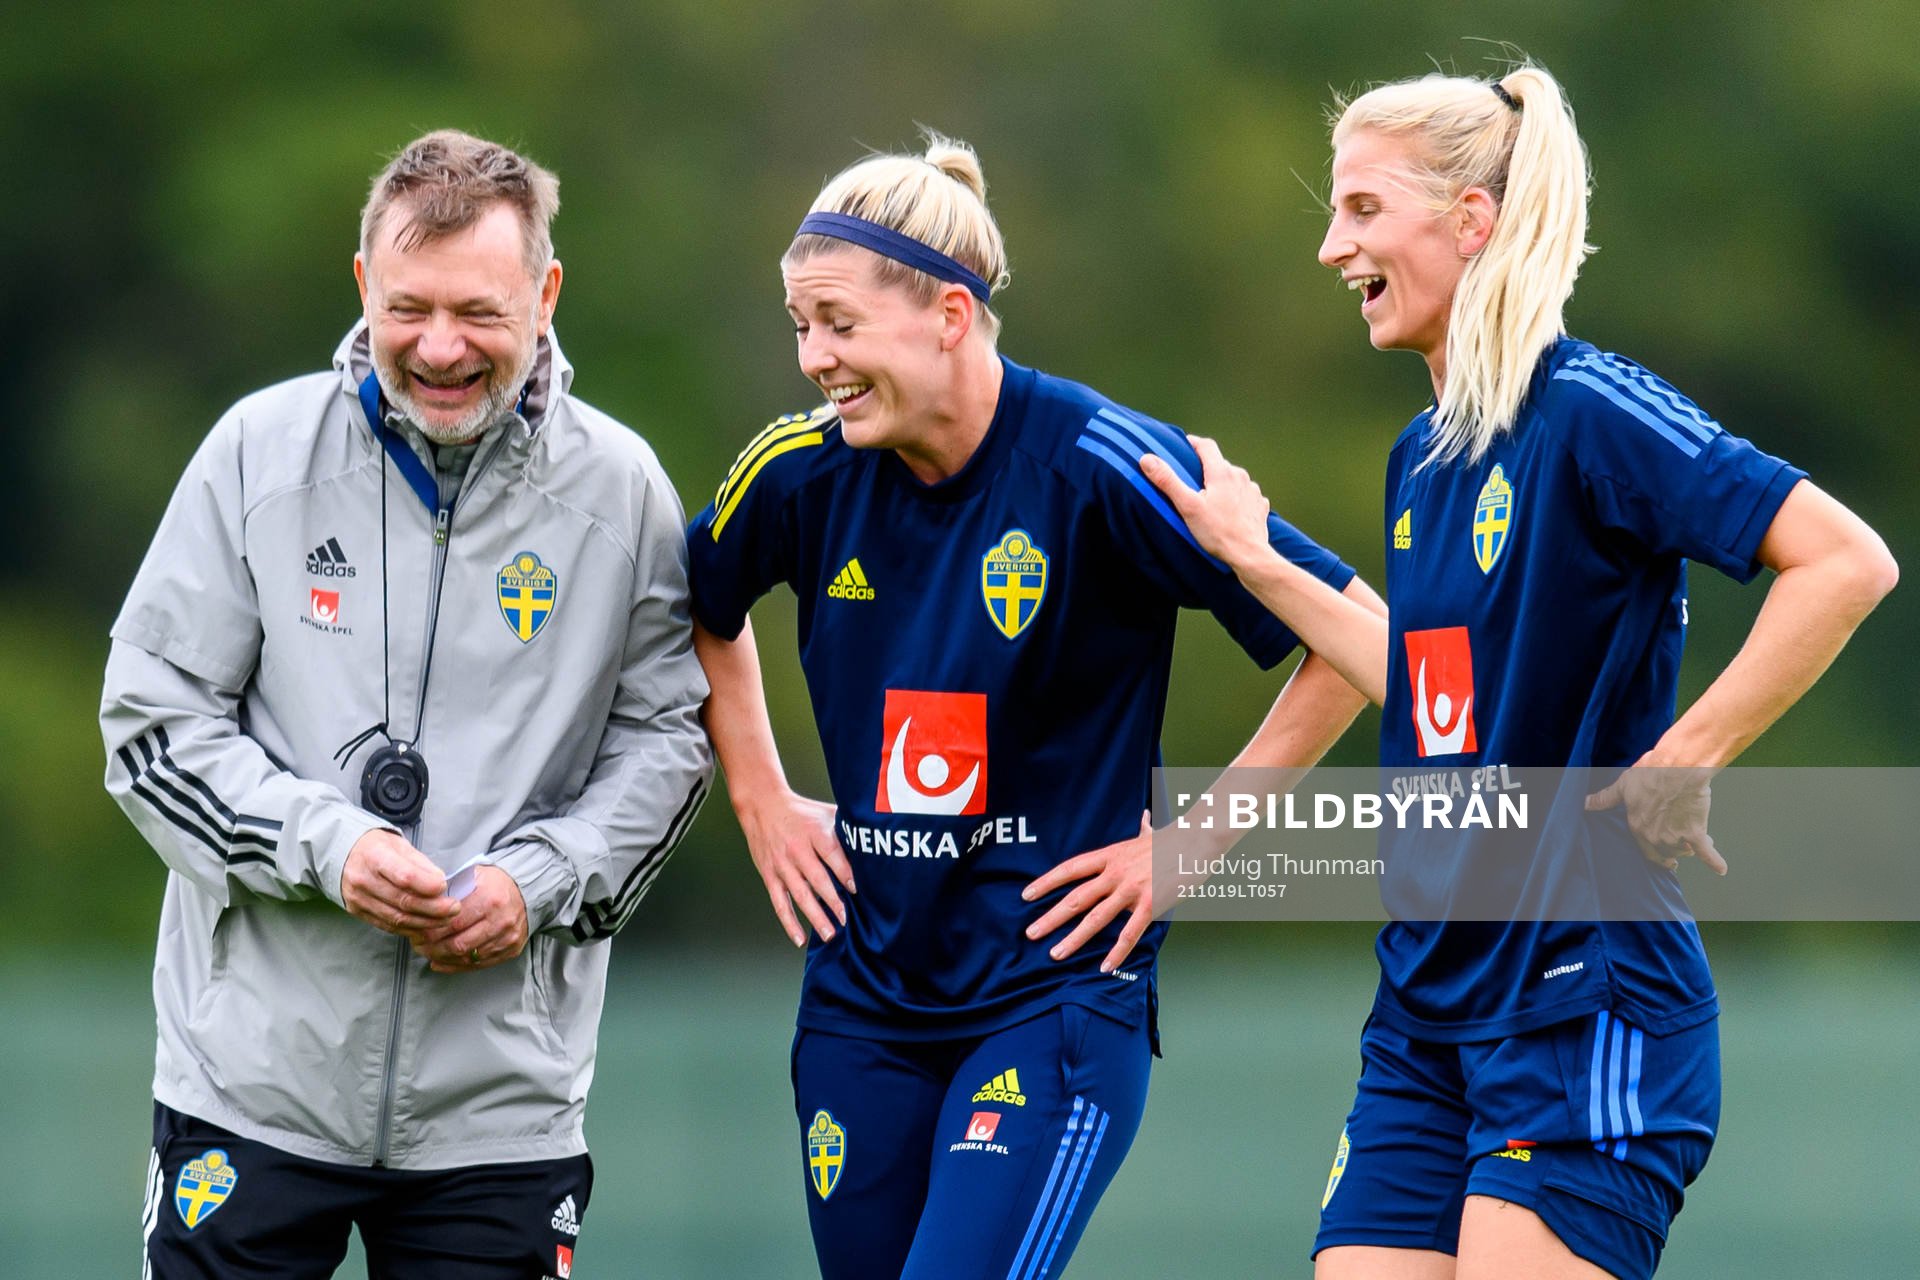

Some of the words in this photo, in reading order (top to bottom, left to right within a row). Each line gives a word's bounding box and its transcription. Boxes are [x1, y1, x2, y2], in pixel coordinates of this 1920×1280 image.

[306, 559, 356, 578] adidas
[993, 561, 1036, 571] SVERIGE
[827, 583, 875, 600] adidas
[967, 816, 1037, 853] SPEL
[972, 1088, 1027, 1106] adidas
[985, 1143, 1009, 1155] SPEL
